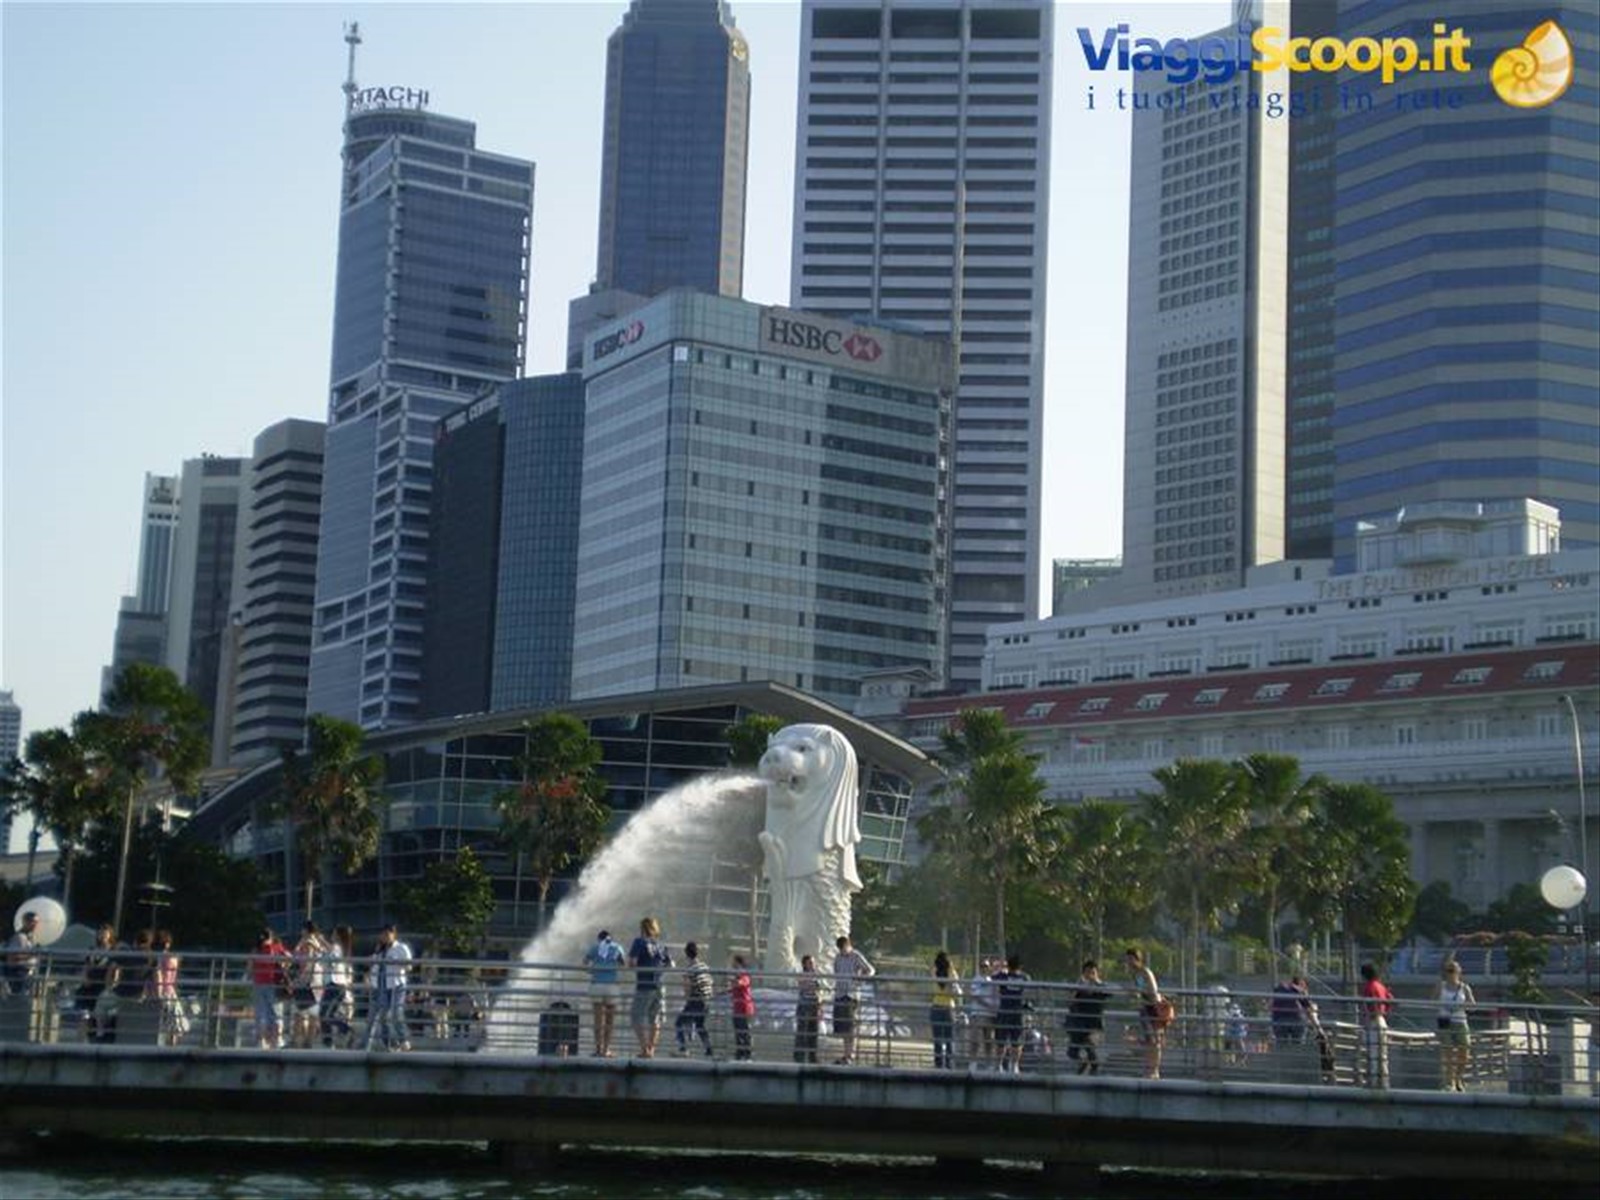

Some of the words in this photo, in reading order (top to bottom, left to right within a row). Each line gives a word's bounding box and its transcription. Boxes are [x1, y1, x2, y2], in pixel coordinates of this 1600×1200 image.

[350, 86, 429, 106] HITACHI
[768, 316, 842, 355] HSBC
[1486, 557, 1556, 583] HOTEL
